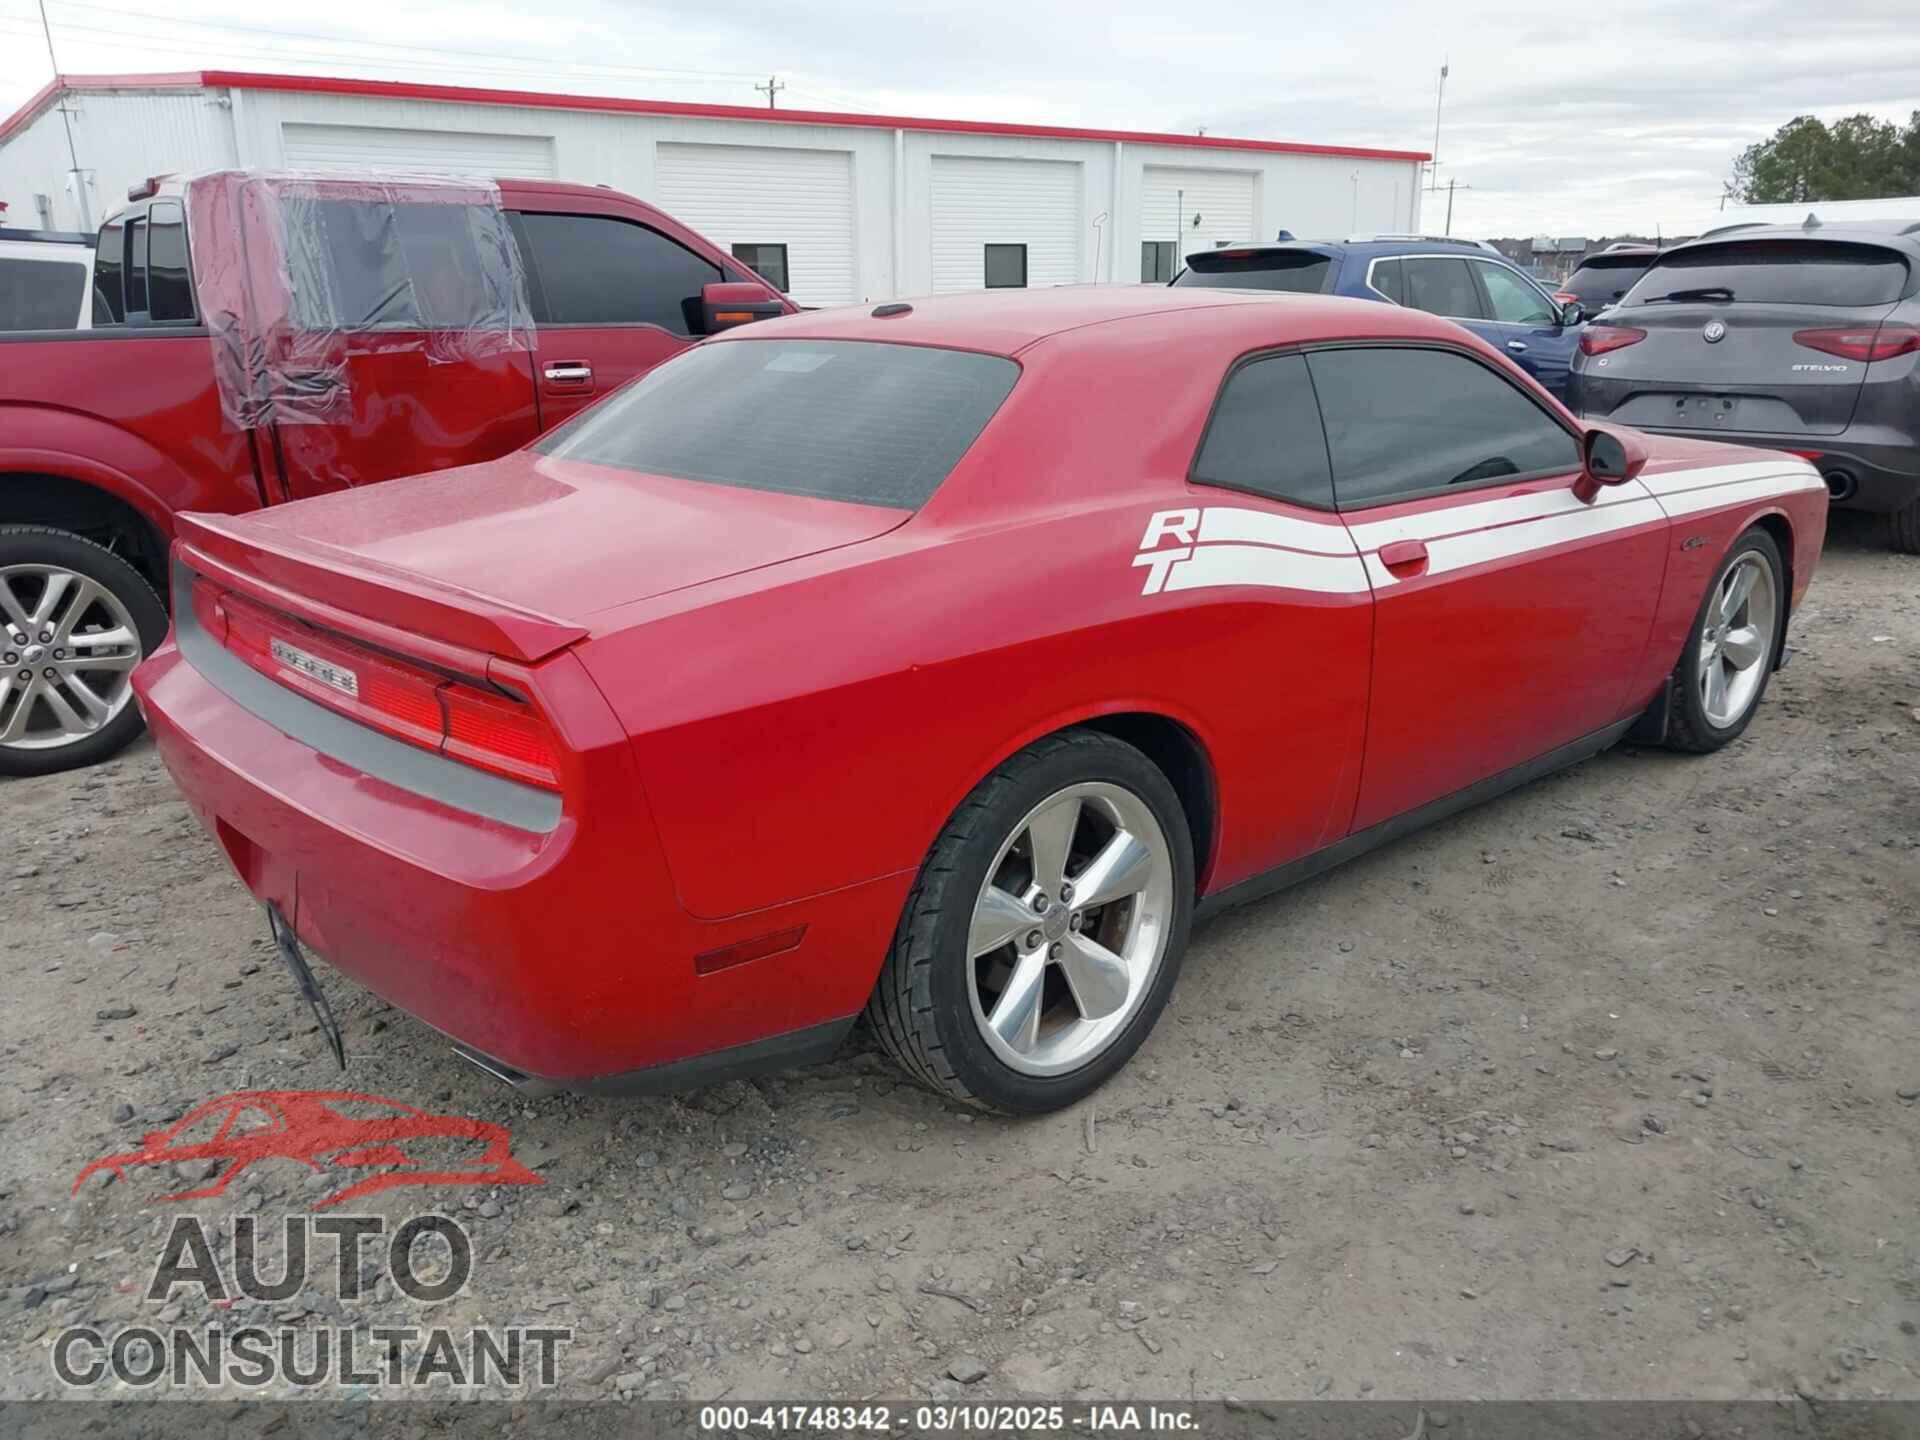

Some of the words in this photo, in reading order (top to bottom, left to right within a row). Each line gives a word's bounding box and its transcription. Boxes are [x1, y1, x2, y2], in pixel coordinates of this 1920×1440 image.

[1791, 364, 1848, 372] STELVIO
[1139, 508, 1200, 550] R
[1131, 547, 1192, 596] T
